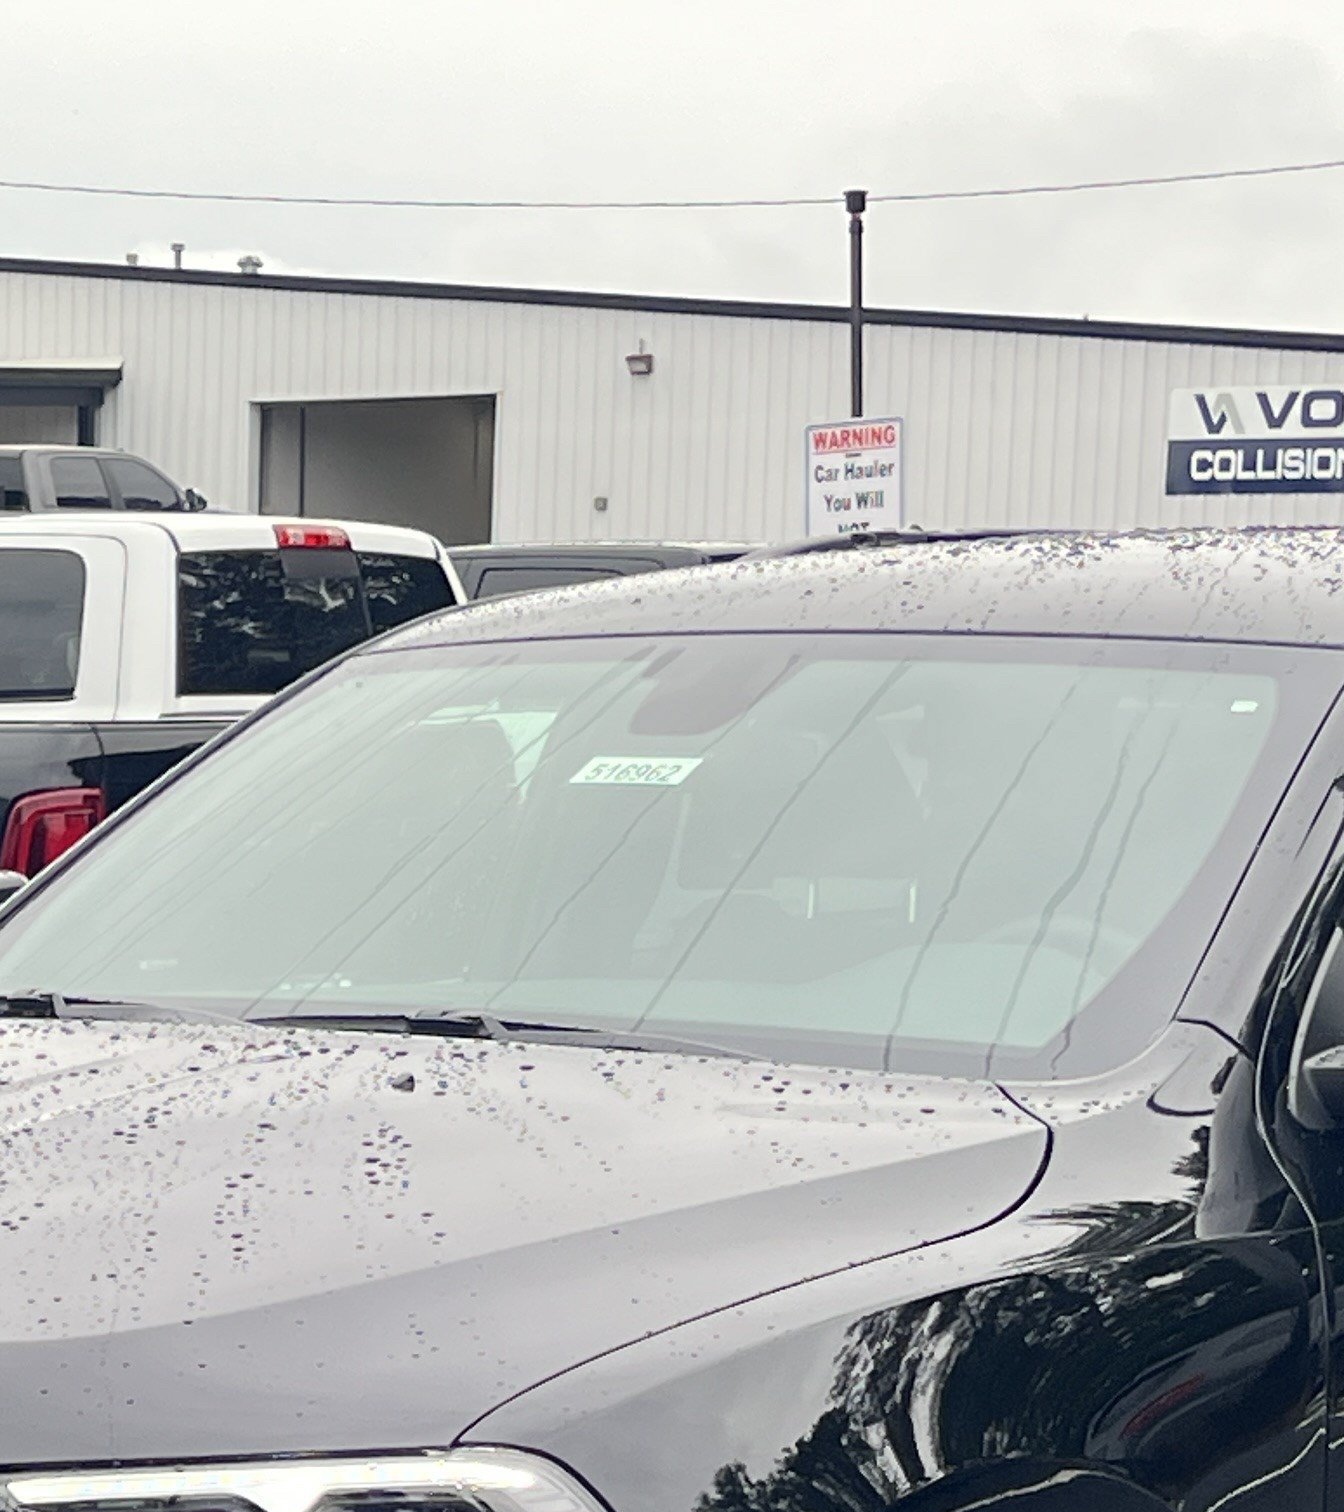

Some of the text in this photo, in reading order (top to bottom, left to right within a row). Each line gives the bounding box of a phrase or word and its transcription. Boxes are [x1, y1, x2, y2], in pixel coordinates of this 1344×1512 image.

[813, 426, 895, 449] WARNING
[814, 459, 896, 483] Car Hauler
[823, 489, 885, 512] You Will
[584, 762, 683, 783] 516962
